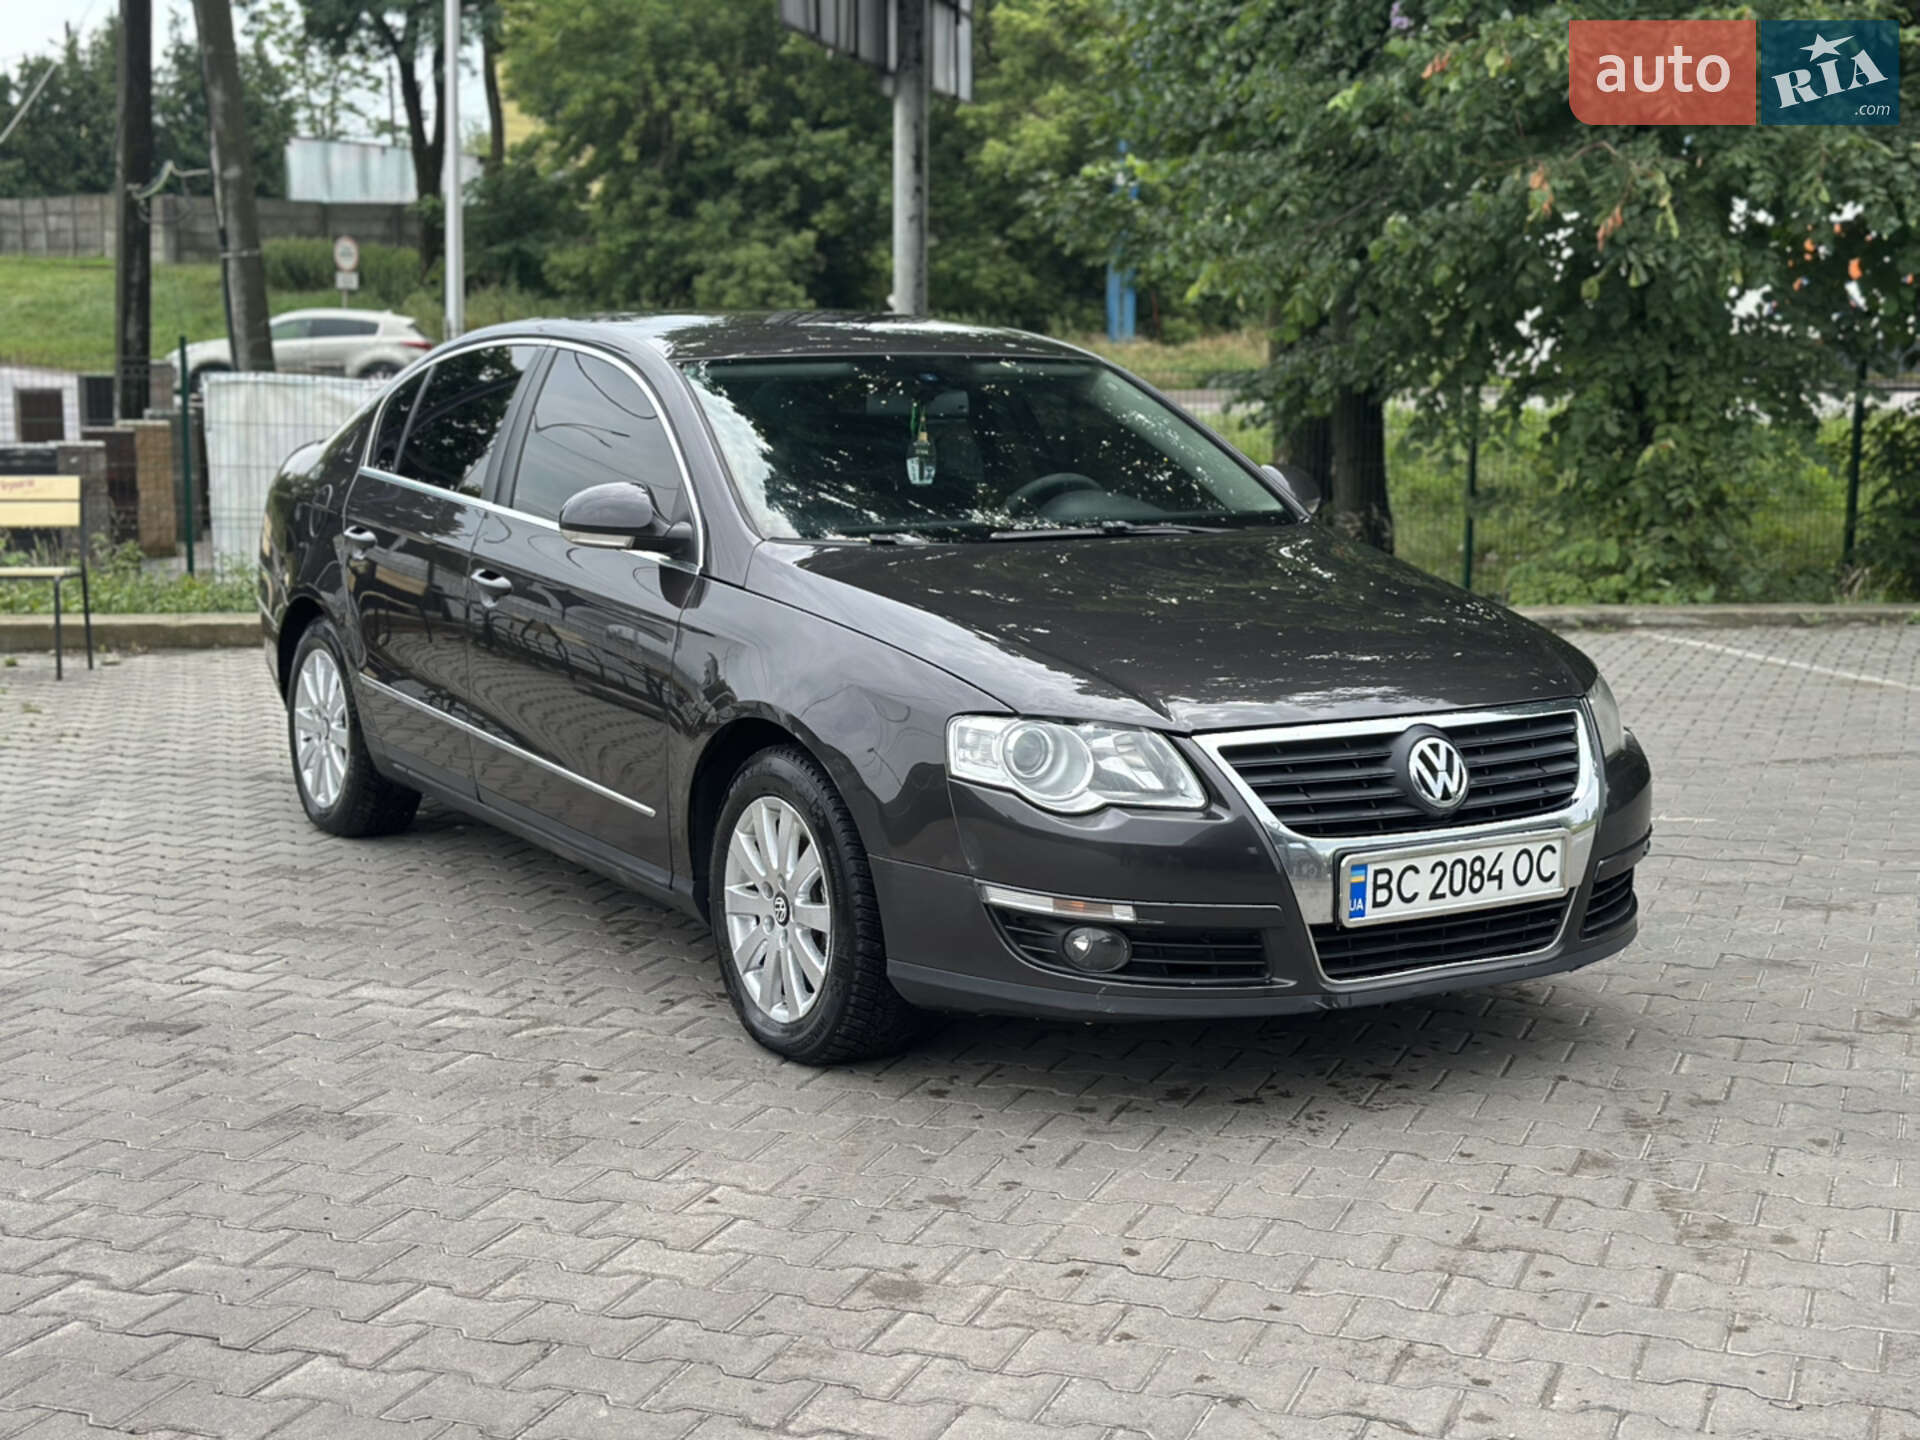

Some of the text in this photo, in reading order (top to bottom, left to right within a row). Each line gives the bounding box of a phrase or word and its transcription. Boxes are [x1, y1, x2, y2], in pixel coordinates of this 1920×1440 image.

[1371, 844, 1557, 909] BC 2084 OC
[1349, 897, 1365, 912] UA
